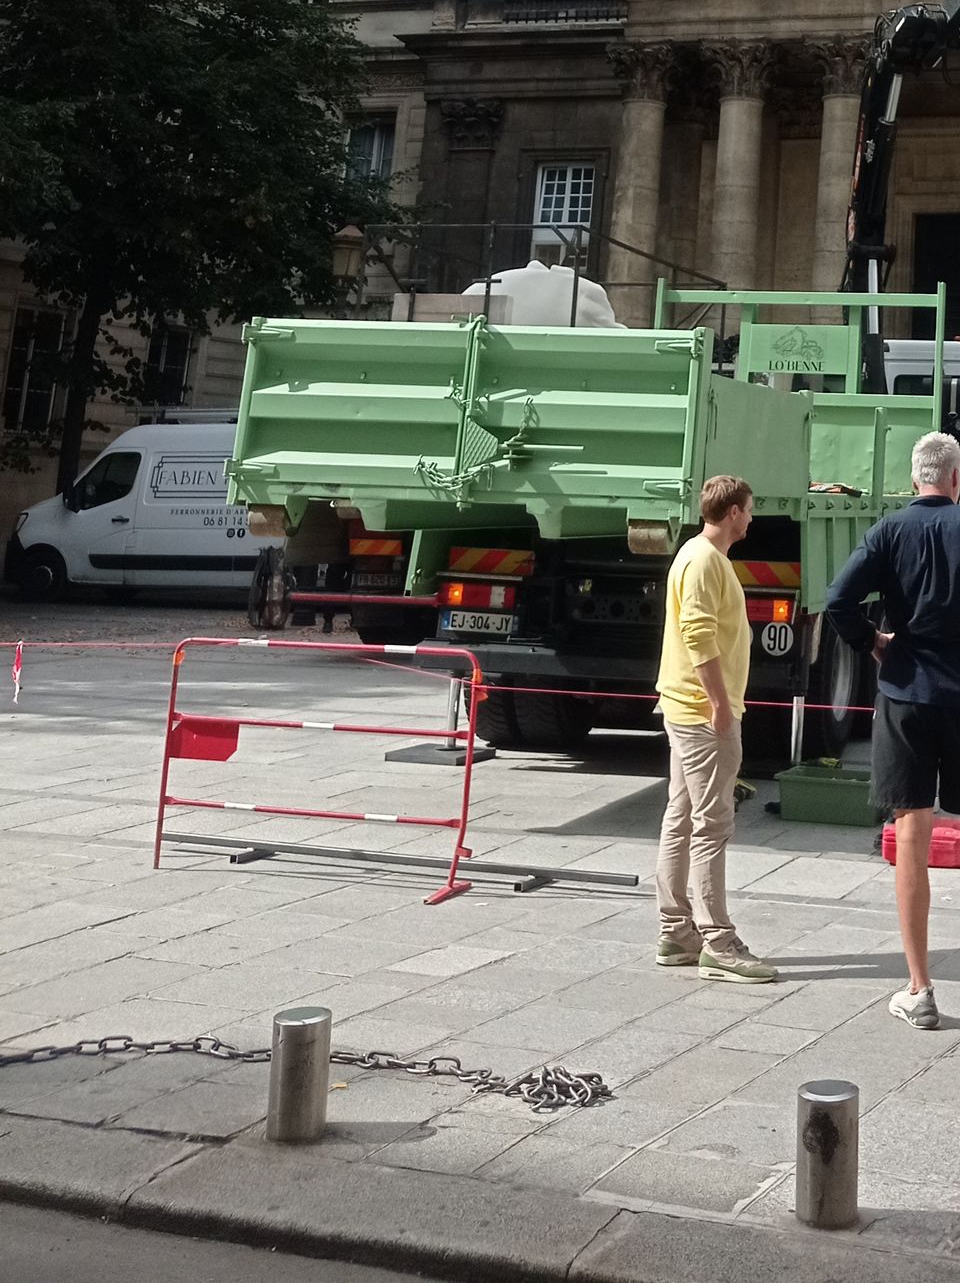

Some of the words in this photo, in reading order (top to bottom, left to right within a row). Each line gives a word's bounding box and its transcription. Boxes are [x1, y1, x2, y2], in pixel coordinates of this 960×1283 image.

[158, 470, 218, 485] FABIEN
[170, 508, 223, 516] FERRONNERIE
[203, 516, 215, 526] 06
[217, 516, 228, 526] 81
[232, 517, 243, 526] 14
[767, 624, 788, 652] 90
